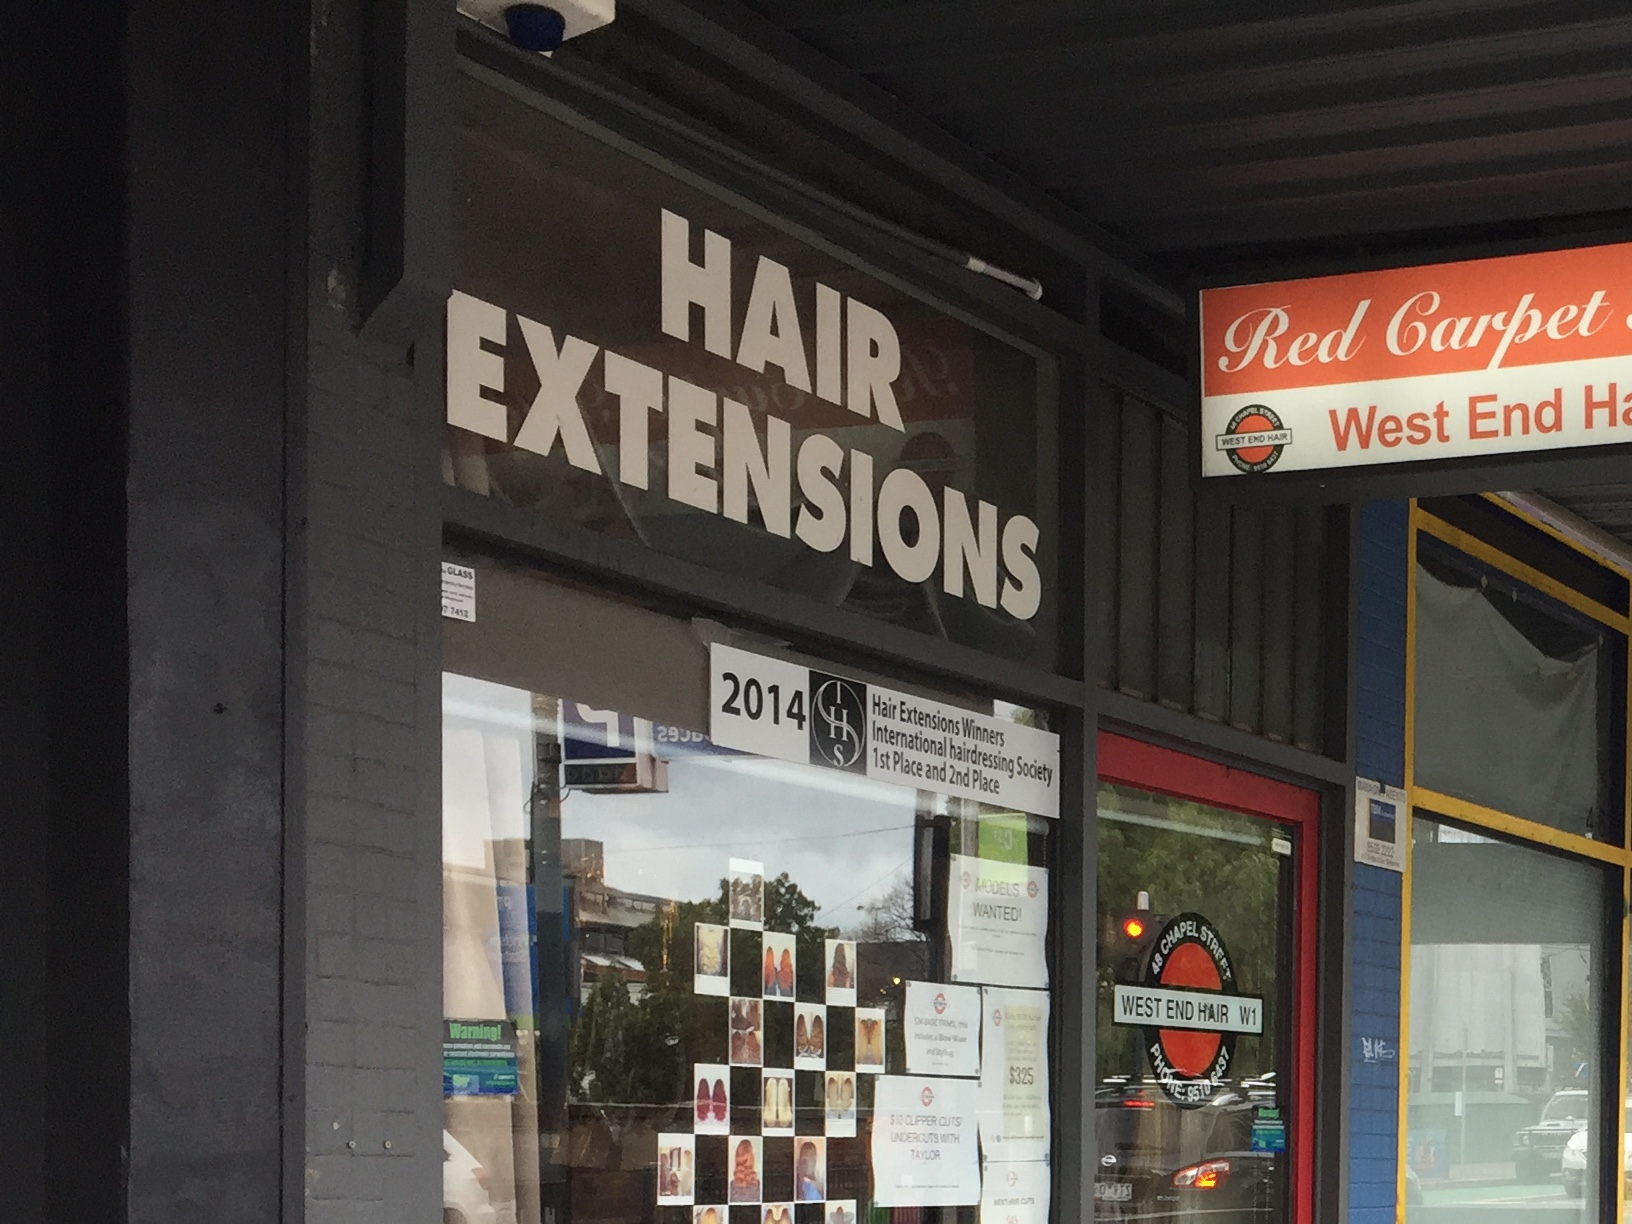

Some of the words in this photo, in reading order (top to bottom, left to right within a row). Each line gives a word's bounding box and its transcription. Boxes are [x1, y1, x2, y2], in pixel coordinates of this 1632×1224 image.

[661, 208, 904, 432] HAIR
[1218, 299, 1368, 374] Red
[1386, 290, 1614, 369] Carpet
[1235, 407, 1258, 422] CHAPEL
[1329, 401, 1450, 452] West
[1466, 387, 1563, 441] End
[1222, 436, 1246, 446] WEST
[1248, 435, 1265, 444] END
[1267, 433, 1288, 442] HAIR
[447, 289, 1041, 620] EXTENSIONS
[447, 567, 473, 580] GLASS
[721, 672, 806, 731] 2014
[872, 693, 897, 721] Hair
[900, 700, 960, 735] Extensions
[962, 717, 1005, 747] Winners
[872, 720, 947, 758] International
[949, 742, 1014, 775] hairdressing
[1016, 755, 1053, 788] Society
[873, 748, 890, 771] 1st
[894, 755, 922, 779] Place
[925, 760, 947, 783] and
[949, 765, 970, 788] 2nd
[973, 773, 1000, 795] Place
[975, 877, 1020, 898] MODELS
[973, 902, 1022, 922] WANTED!
[1151, 953, 1164, 975] 48
[1160, 920, 1199, 955] CHAPEL
[1199, 925, 1231, 981] STREET
[1121, 995, 1162, 1018] WEST
[1166, 999, 1194, 1021] END
[1198, 1002, 1229, 1024] HAIR
[1239, 1005, 1257, 1026] W1
[450, 1022, 502, 1041] Warning!
[1009, 1066, 1034, 1085] $325
[906, 1115, 937, 1126] CLIPPER
[891, 1132, 939, 1143] UNDERCUTS
[940, 1133, 960, 1143] WITH
[910, 1149, 940, 1160] TAYLOR
